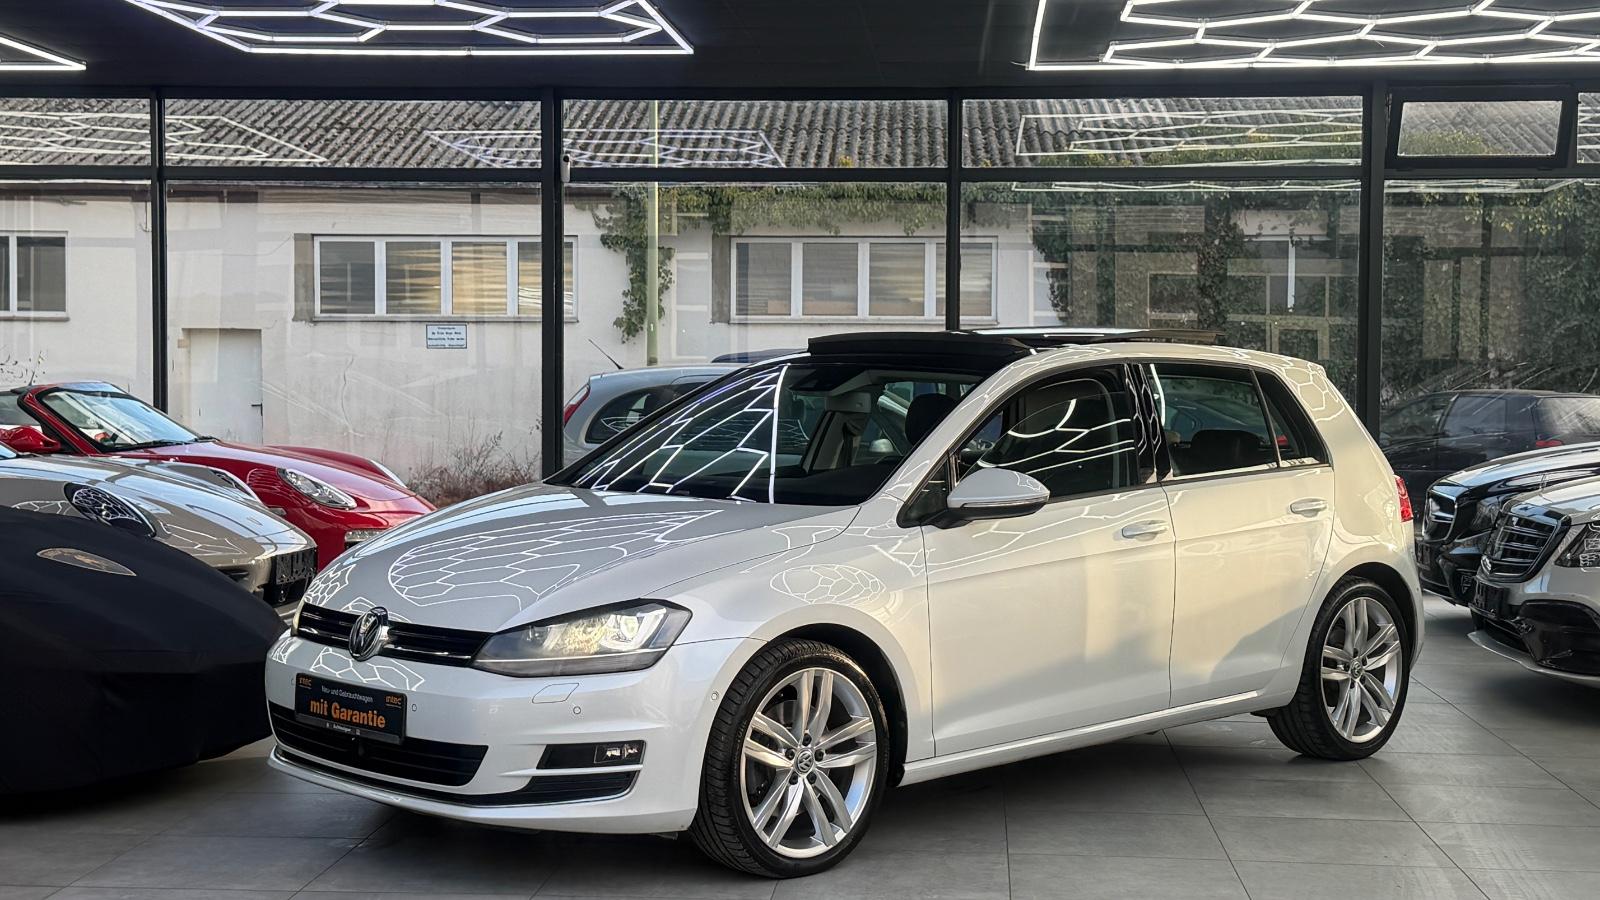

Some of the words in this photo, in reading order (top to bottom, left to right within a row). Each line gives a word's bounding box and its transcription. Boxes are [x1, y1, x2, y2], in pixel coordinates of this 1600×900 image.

[339, 689, 373, 703] Gebrauchtwagen
[310, 699, 328, 716] mit
[331, 702, 386, 728] Garantie
